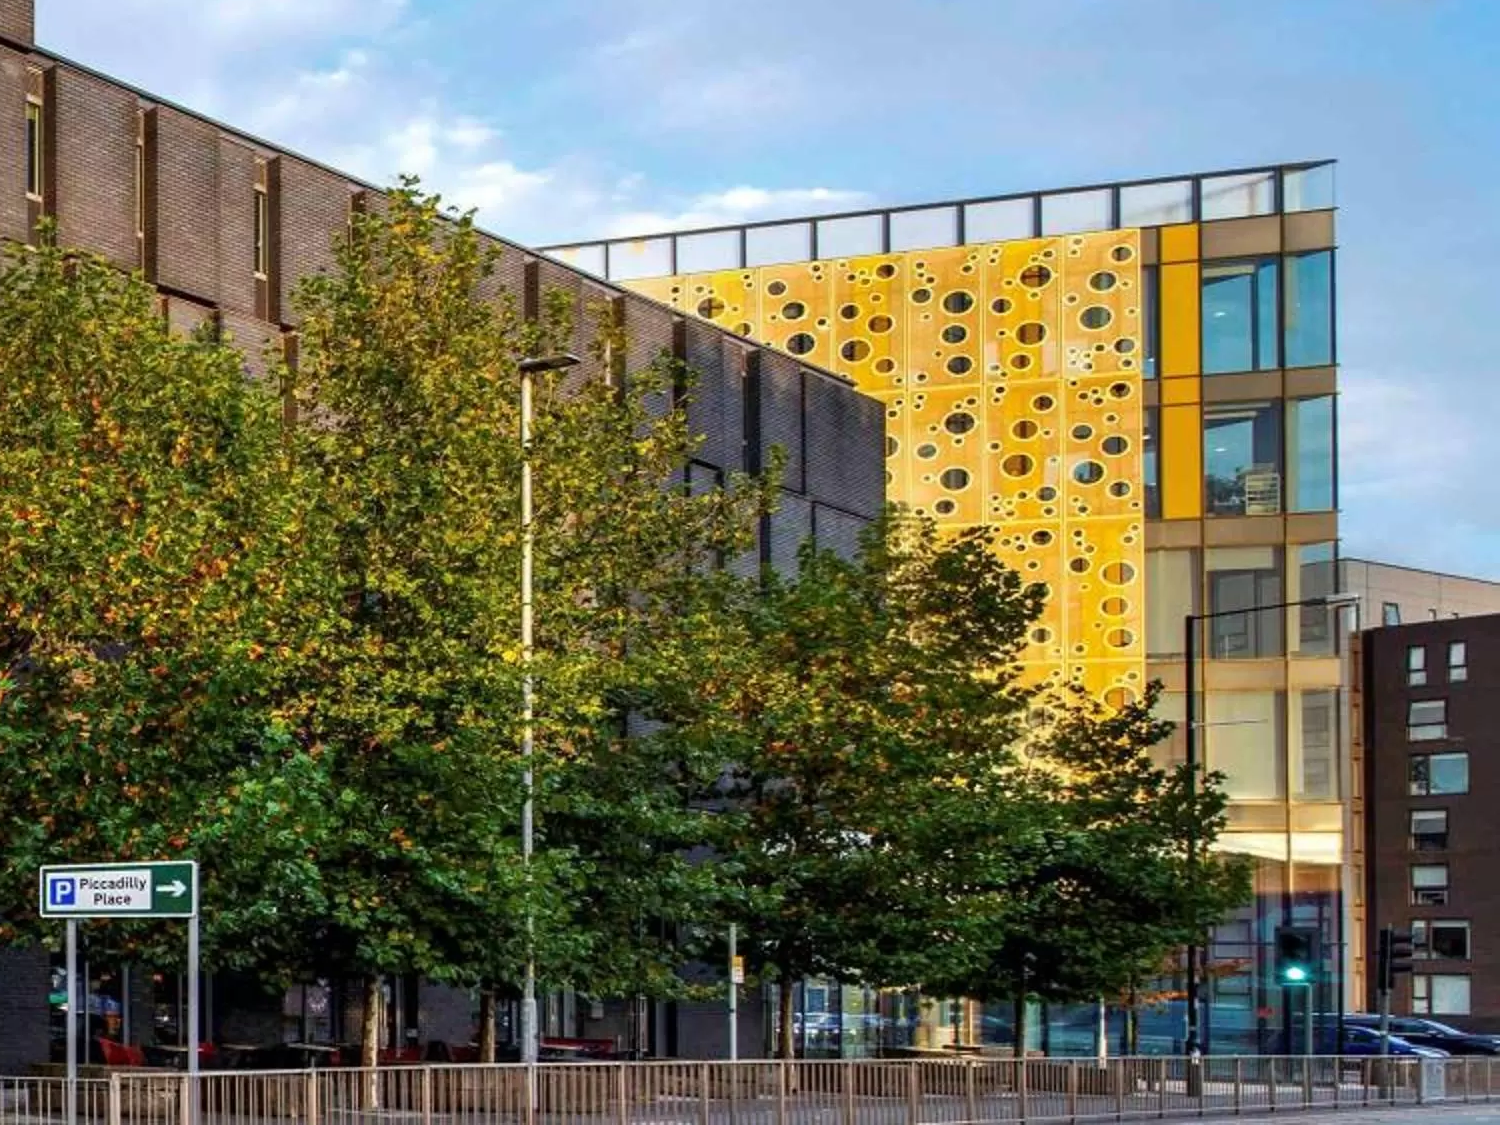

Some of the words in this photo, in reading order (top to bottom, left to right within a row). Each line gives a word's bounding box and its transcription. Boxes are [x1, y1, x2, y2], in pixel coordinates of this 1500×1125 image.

[79, 877, 147, 891] Piccadilly
[55, 881, 71, 903] P
[93, 893, 132, 906] Place
